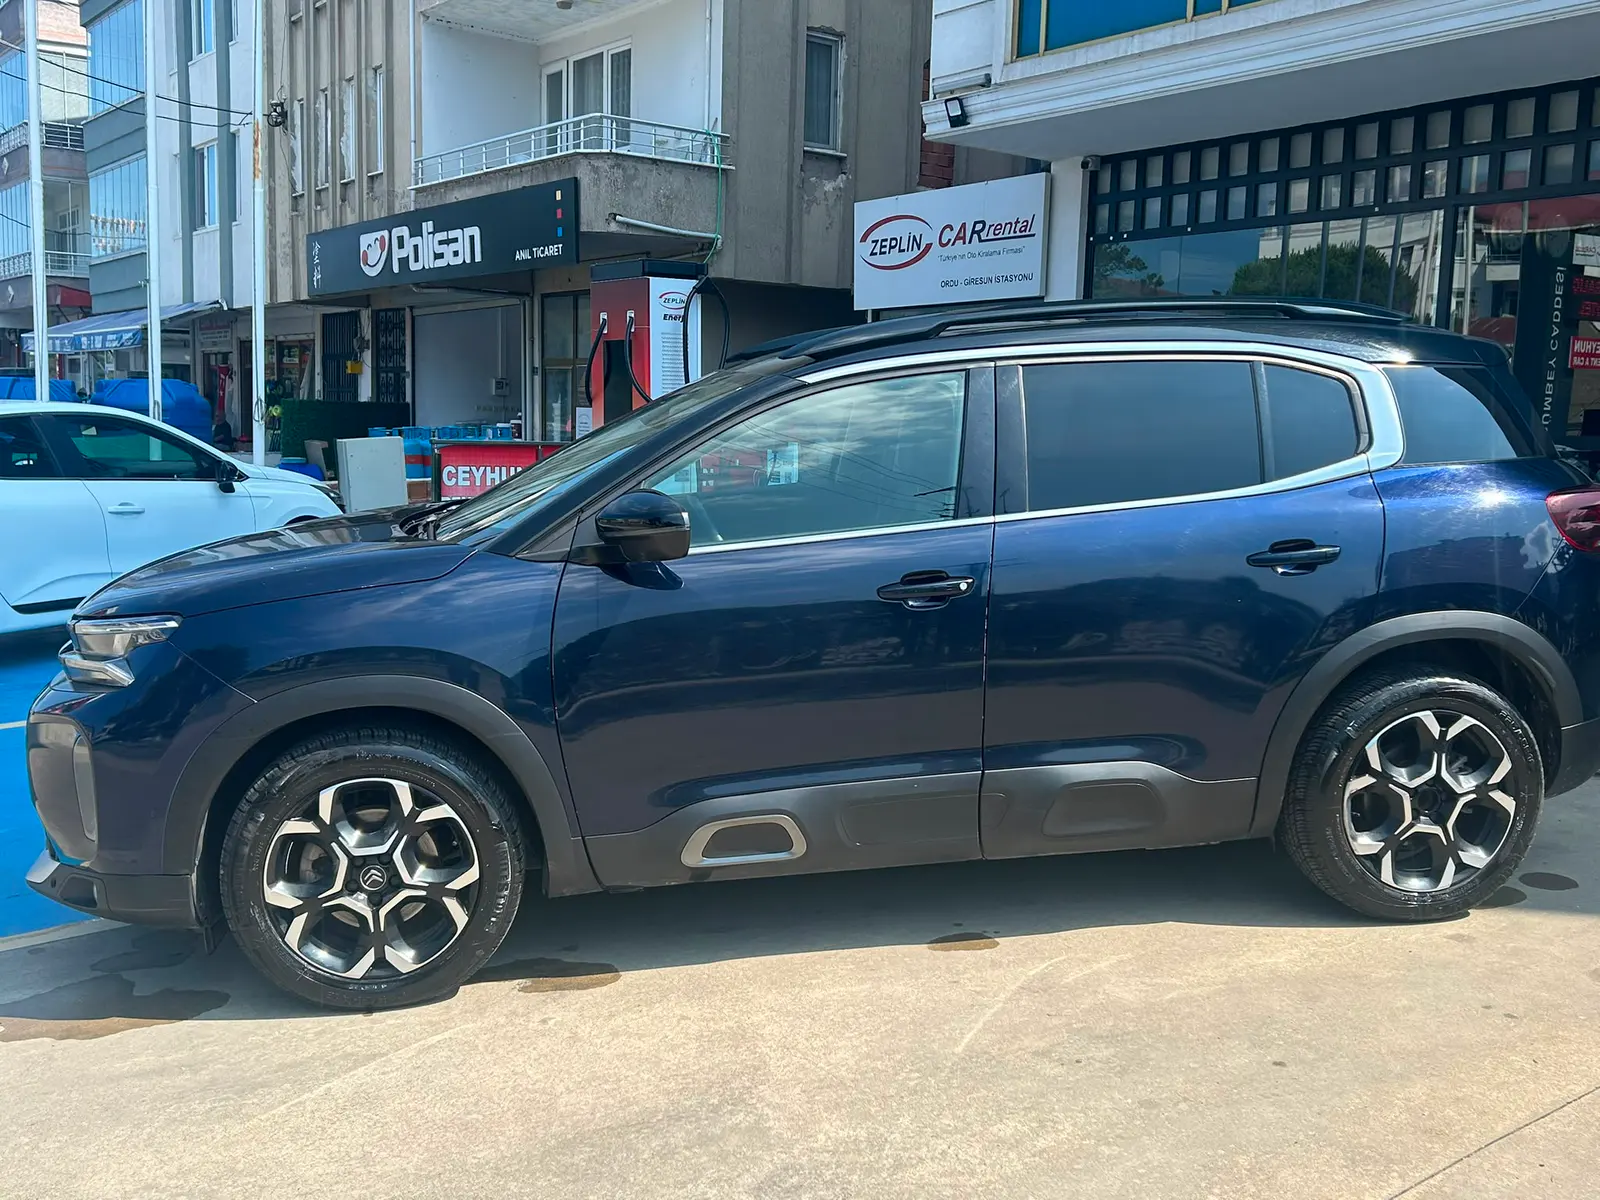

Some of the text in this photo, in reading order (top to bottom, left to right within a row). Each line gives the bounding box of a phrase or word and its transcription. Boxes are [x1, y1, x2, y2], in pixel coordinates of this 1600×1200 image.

[391, 220, 482, 274] Polisan
[869, 231, 923, 257] ZEPLİN
[515, 249, 532, 261] ANIL
[967, 251, 977, 260] Oto
[940, 279, 959, 288] ORDU
[963, 276, 993, 287] GİRESUN
[994, 272, 1034, 284] İSTASYONU
